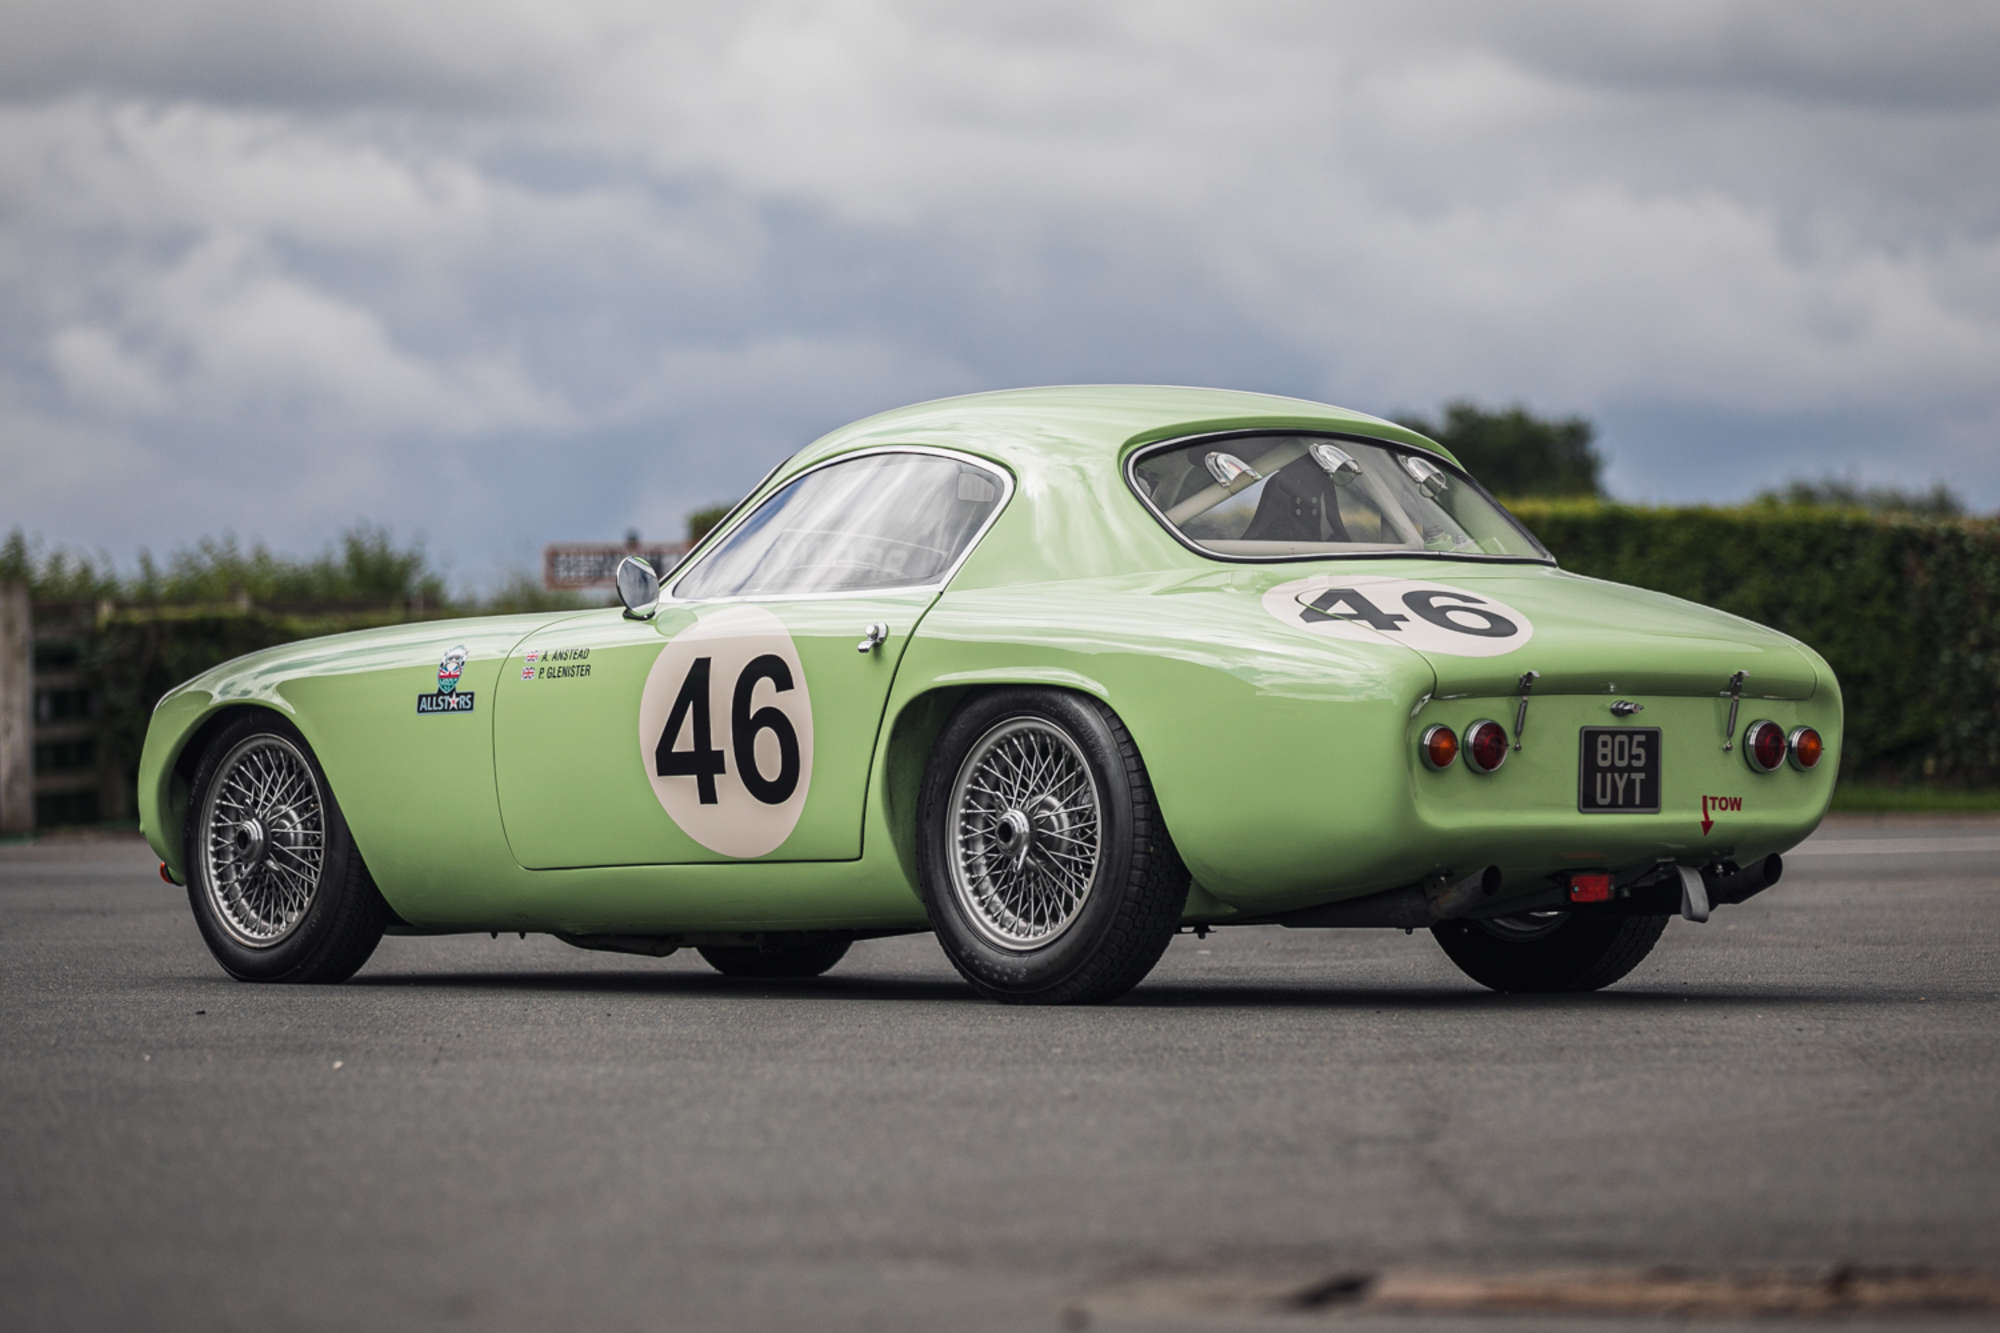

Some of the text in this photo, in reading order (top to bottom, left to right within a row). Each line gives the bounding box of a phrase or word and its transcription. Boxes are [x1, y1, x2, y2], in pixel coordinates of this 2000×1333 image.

[1299, 587, 1518, 638] 46
[551, 648, 590, 662] ANSTEAD
[538, 664, 591, 679] P. GLENISTER
[655, 654, 800, 805] 46
[1596, 734, 1646, 767] 805
[1596, 773, 1646, 805] UYT
[1709, 797, 1742, 811] TOW
